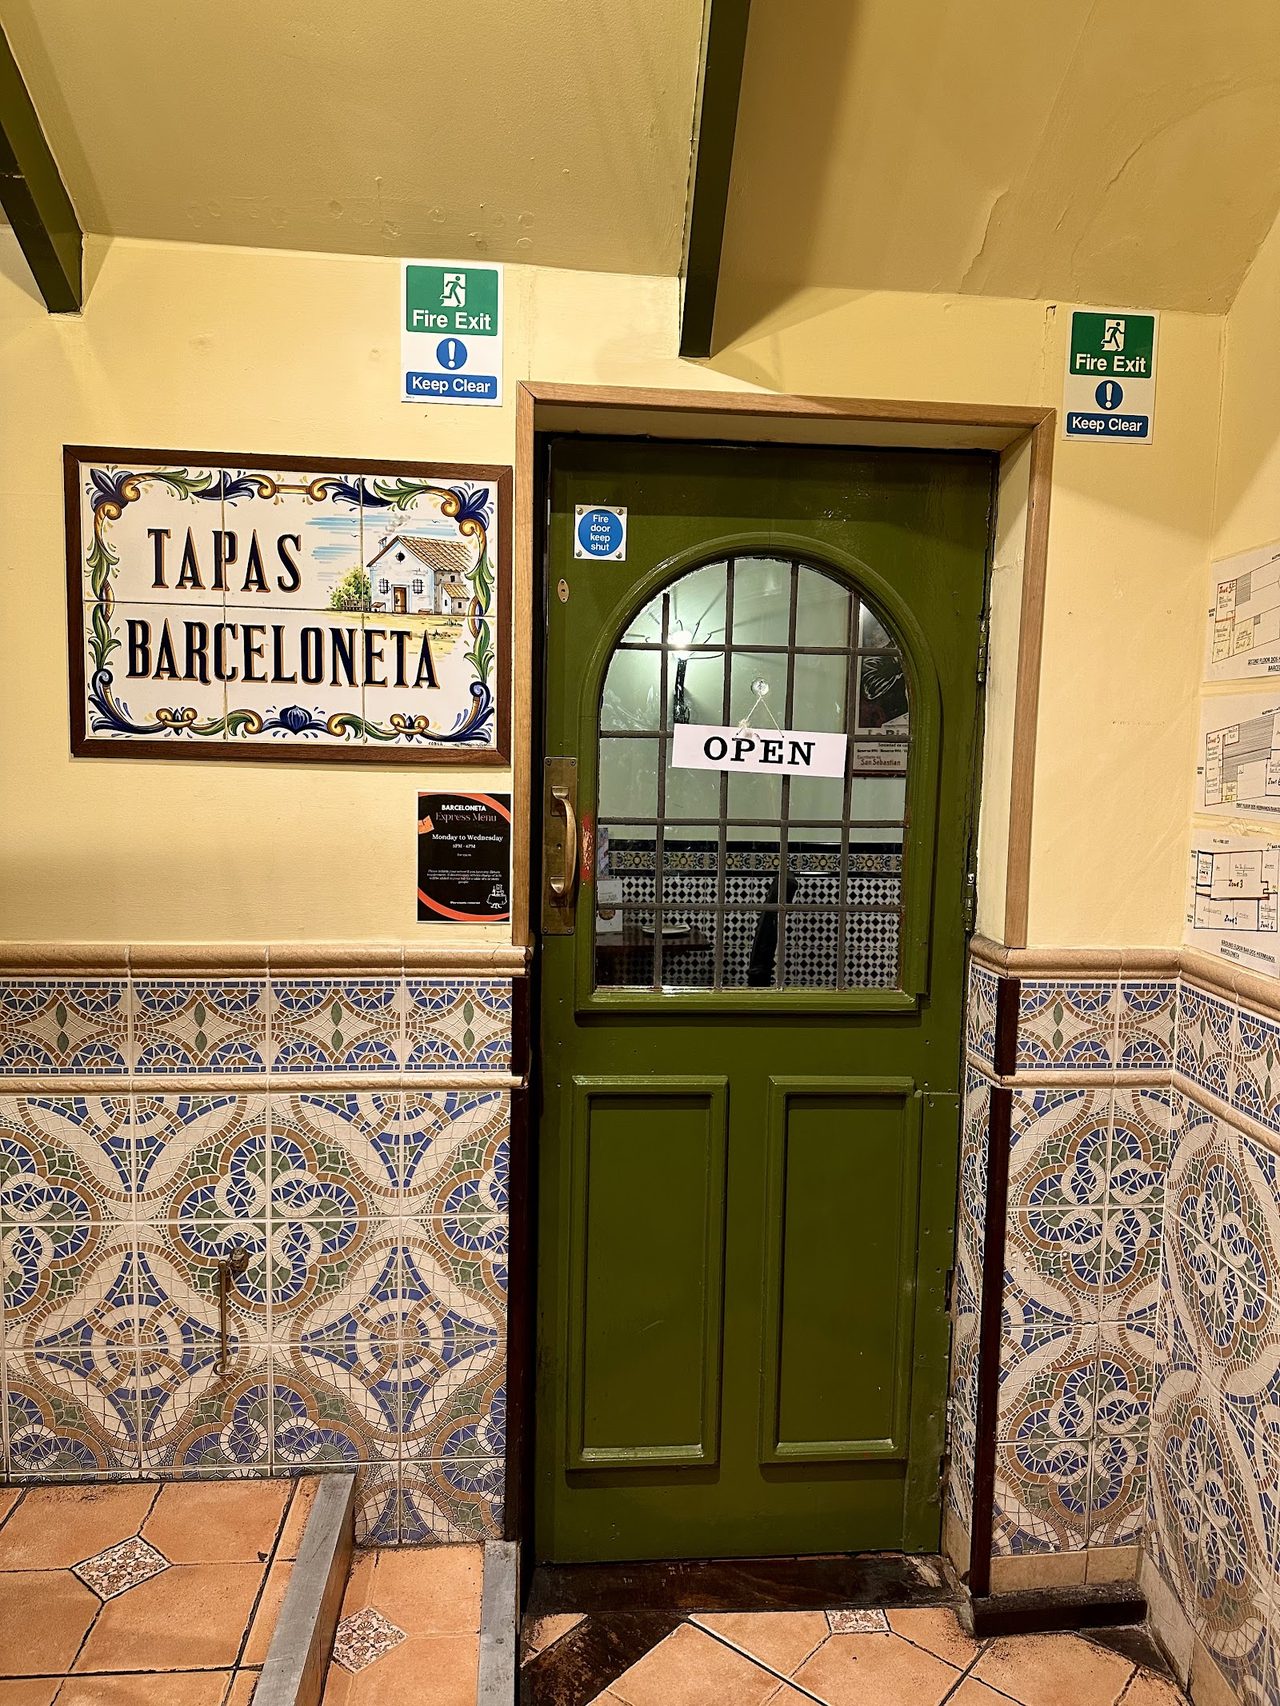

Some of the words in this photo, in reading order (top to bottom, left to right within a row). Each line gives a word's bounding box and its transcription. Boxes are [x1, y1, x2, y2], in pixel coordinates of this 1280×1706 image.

[412, 309, 449, 328] Fire
[455, 312, 492, 330] Exit
[1075, 353, 1108, 371] Fire
[1113, 355, 1147, 373] Exit
[412, 376, 449, 394] Keep
[452, 378, 491, 393] Clear
[1072, 416, 1105, 433] Keep
[1108, 418, 1143, 432] Clear
[592, 514, 609, 523] Fire
[590, 524, 611, 532] door
[590, 533, 611, 543] keep
[590, 543, 610, 551] shut
[147, 526, 302, 594] TAPAS
[125, 617, 441, 689] BARCELONETA
[703, 735, 816, 767] OPEN
[441, 804, 487, 812] BARCELONETA
[435, 812, 471, 823] Express
[472, 813, 497, 822] Menu
[432, 833, 458, 841] Monday
[467, 834, 503, 842] Wednesday
